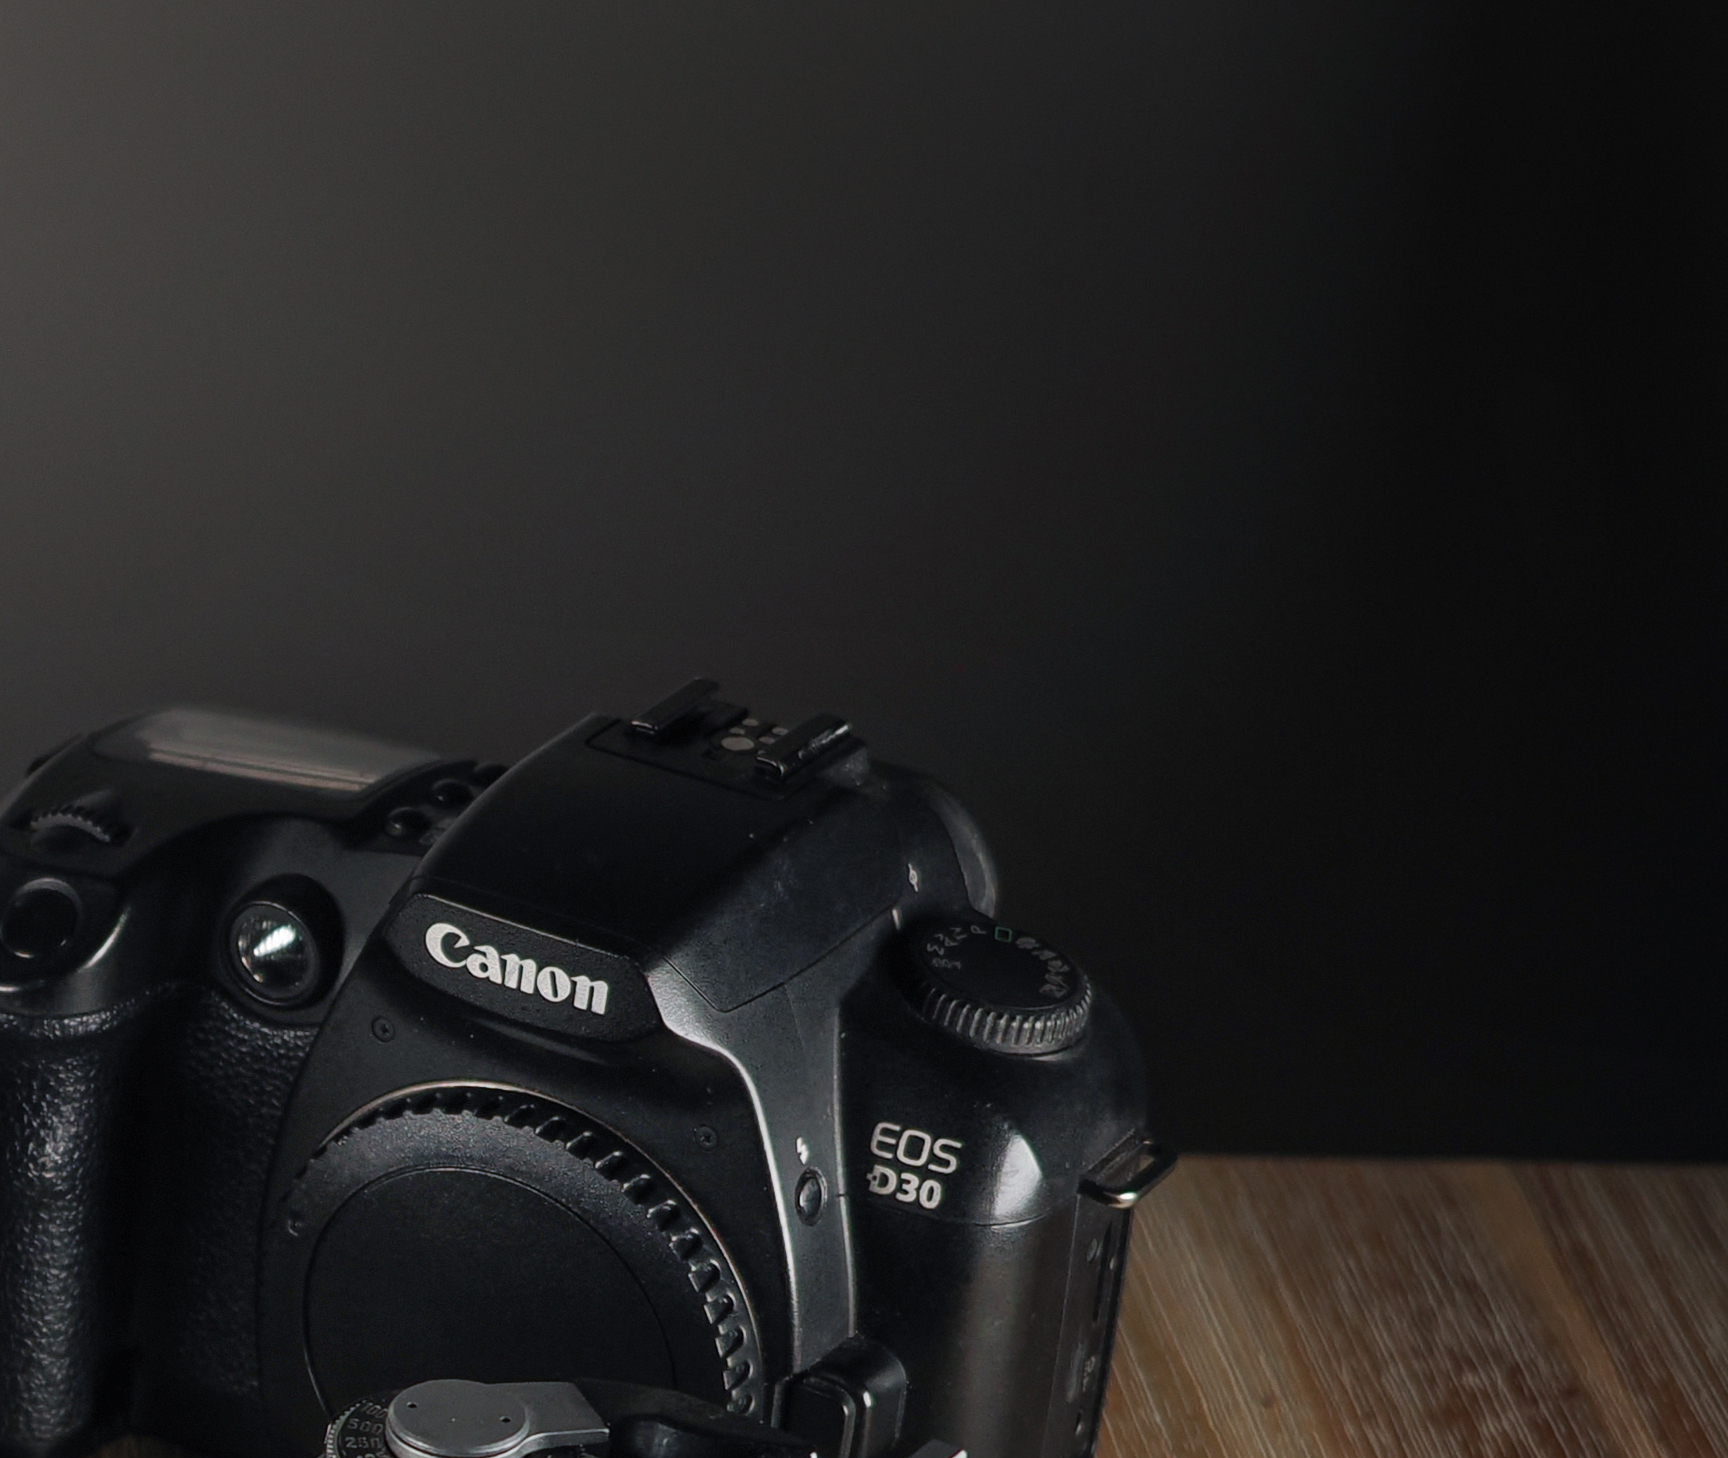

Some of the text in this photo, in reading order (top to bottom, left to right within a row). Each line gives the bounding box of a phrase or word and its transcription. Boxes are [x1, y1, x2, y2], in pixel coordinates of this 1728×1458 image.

[425, 922, 608, 1015] Canon
[870, 1122, 962, 1174] EOS
[866, 1165, 941, 1210] D30
